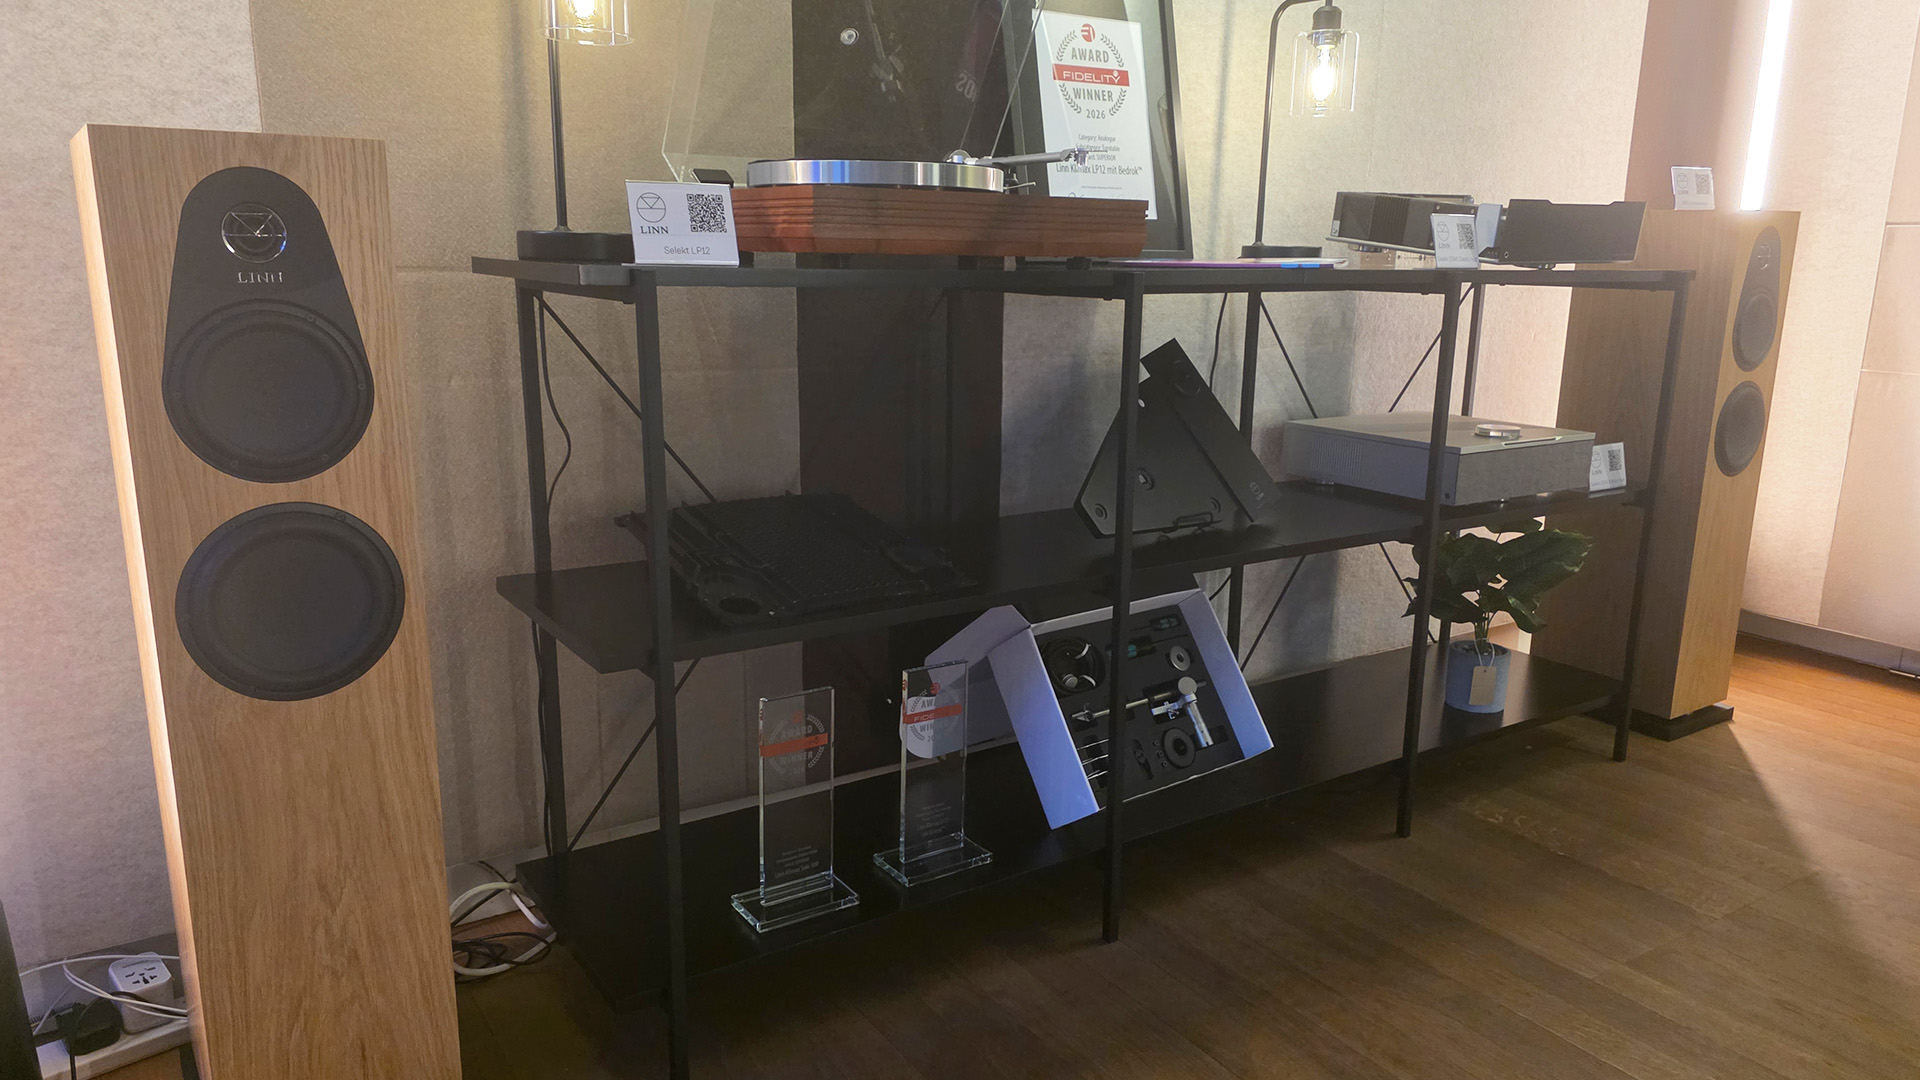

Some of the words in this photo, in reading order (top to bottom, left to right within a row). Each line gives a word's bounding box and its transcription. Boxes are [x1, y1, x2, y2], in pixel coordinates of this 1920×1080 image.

[1071, 47, 1110, 63] AWARD
[1062, 70, 1121, 84] FIDELITY
[1072, 87, 1114, 102] WINNER
[1086, 109, 1106, 119] 2026
[1056, 163, 1070, 173] Linn
[1092, 164, 1106, 174] LP12
[1107, 165, 1118, 175] mit
[640, 225, 669, 235] LINN
[663, 246, 690, 255] Selekt
[691, 246, 711, 255] LP12
[237, 271, 283, 284] LINN
